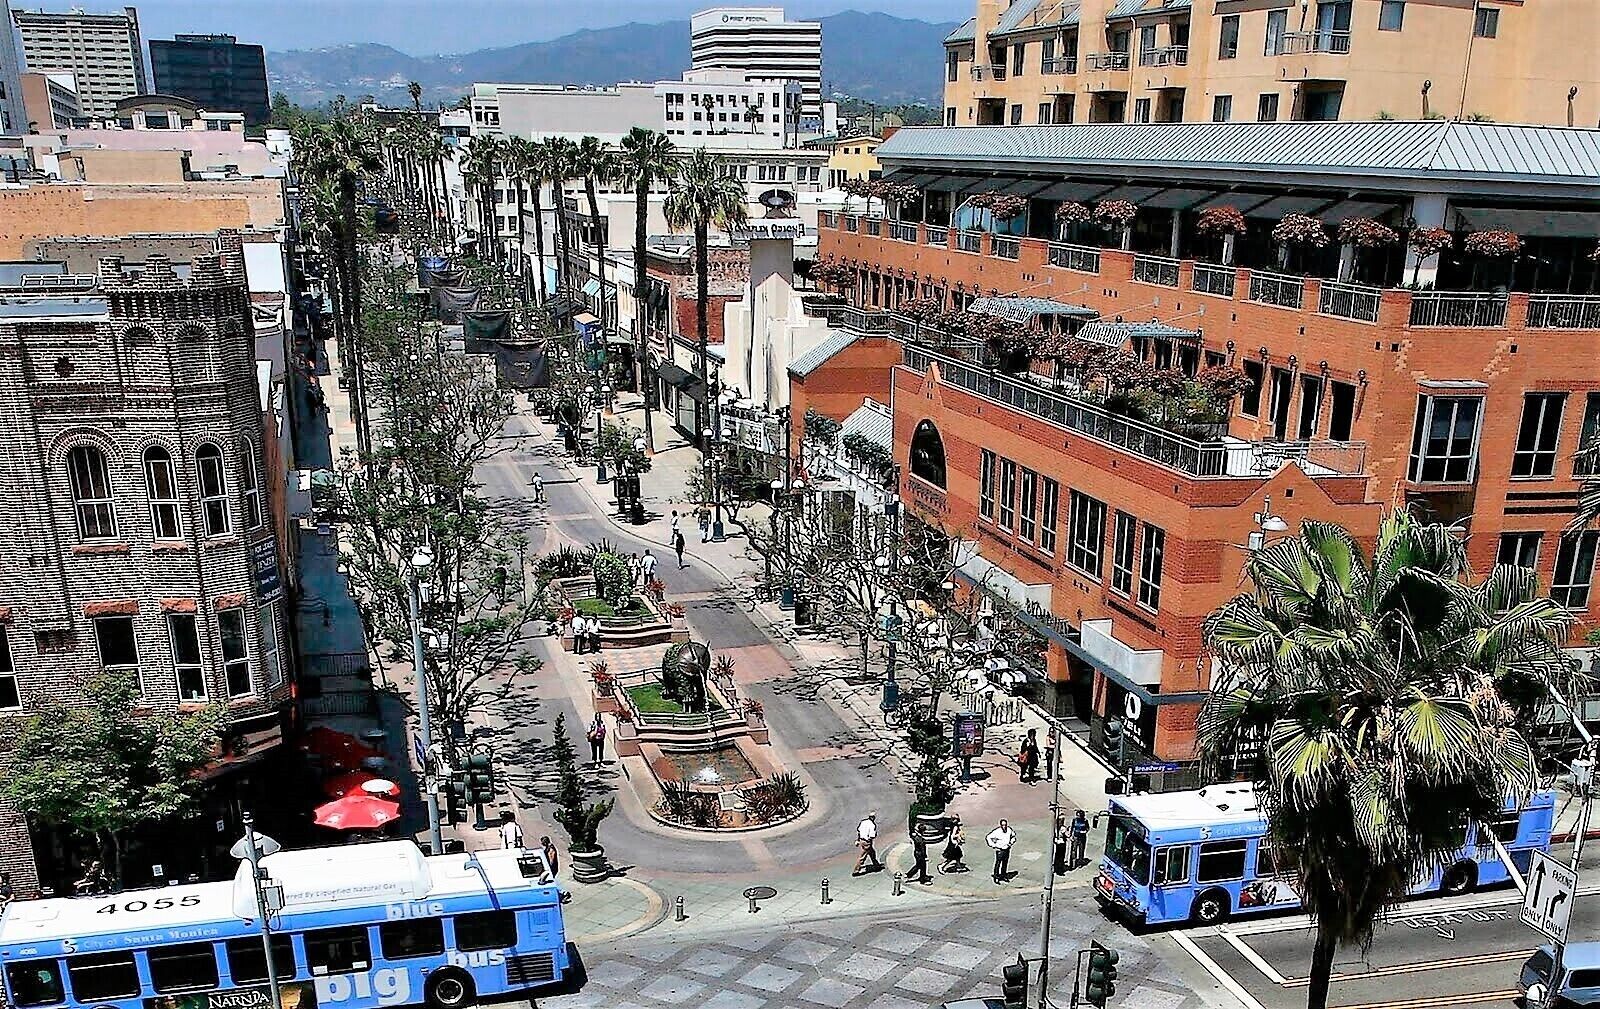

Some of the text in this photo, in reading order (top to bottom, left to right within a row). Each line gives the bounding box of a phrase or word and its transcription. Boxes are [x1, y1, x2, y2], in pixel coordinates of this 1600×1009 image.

[96, 894, 201, 915] 4055
[386, 901, 444, 919] blue
[1523, 906, 1542, 923] ONLY
[123, 933, 164, 946] Santa
[167, 926, 220, 940] Monica
[1545, 919, 1564, 937] ONLY
[447, 949, 507, 969] bus
[313, 966, 412, 1006] big
[207, 990, 270, 1009] NARNIA
